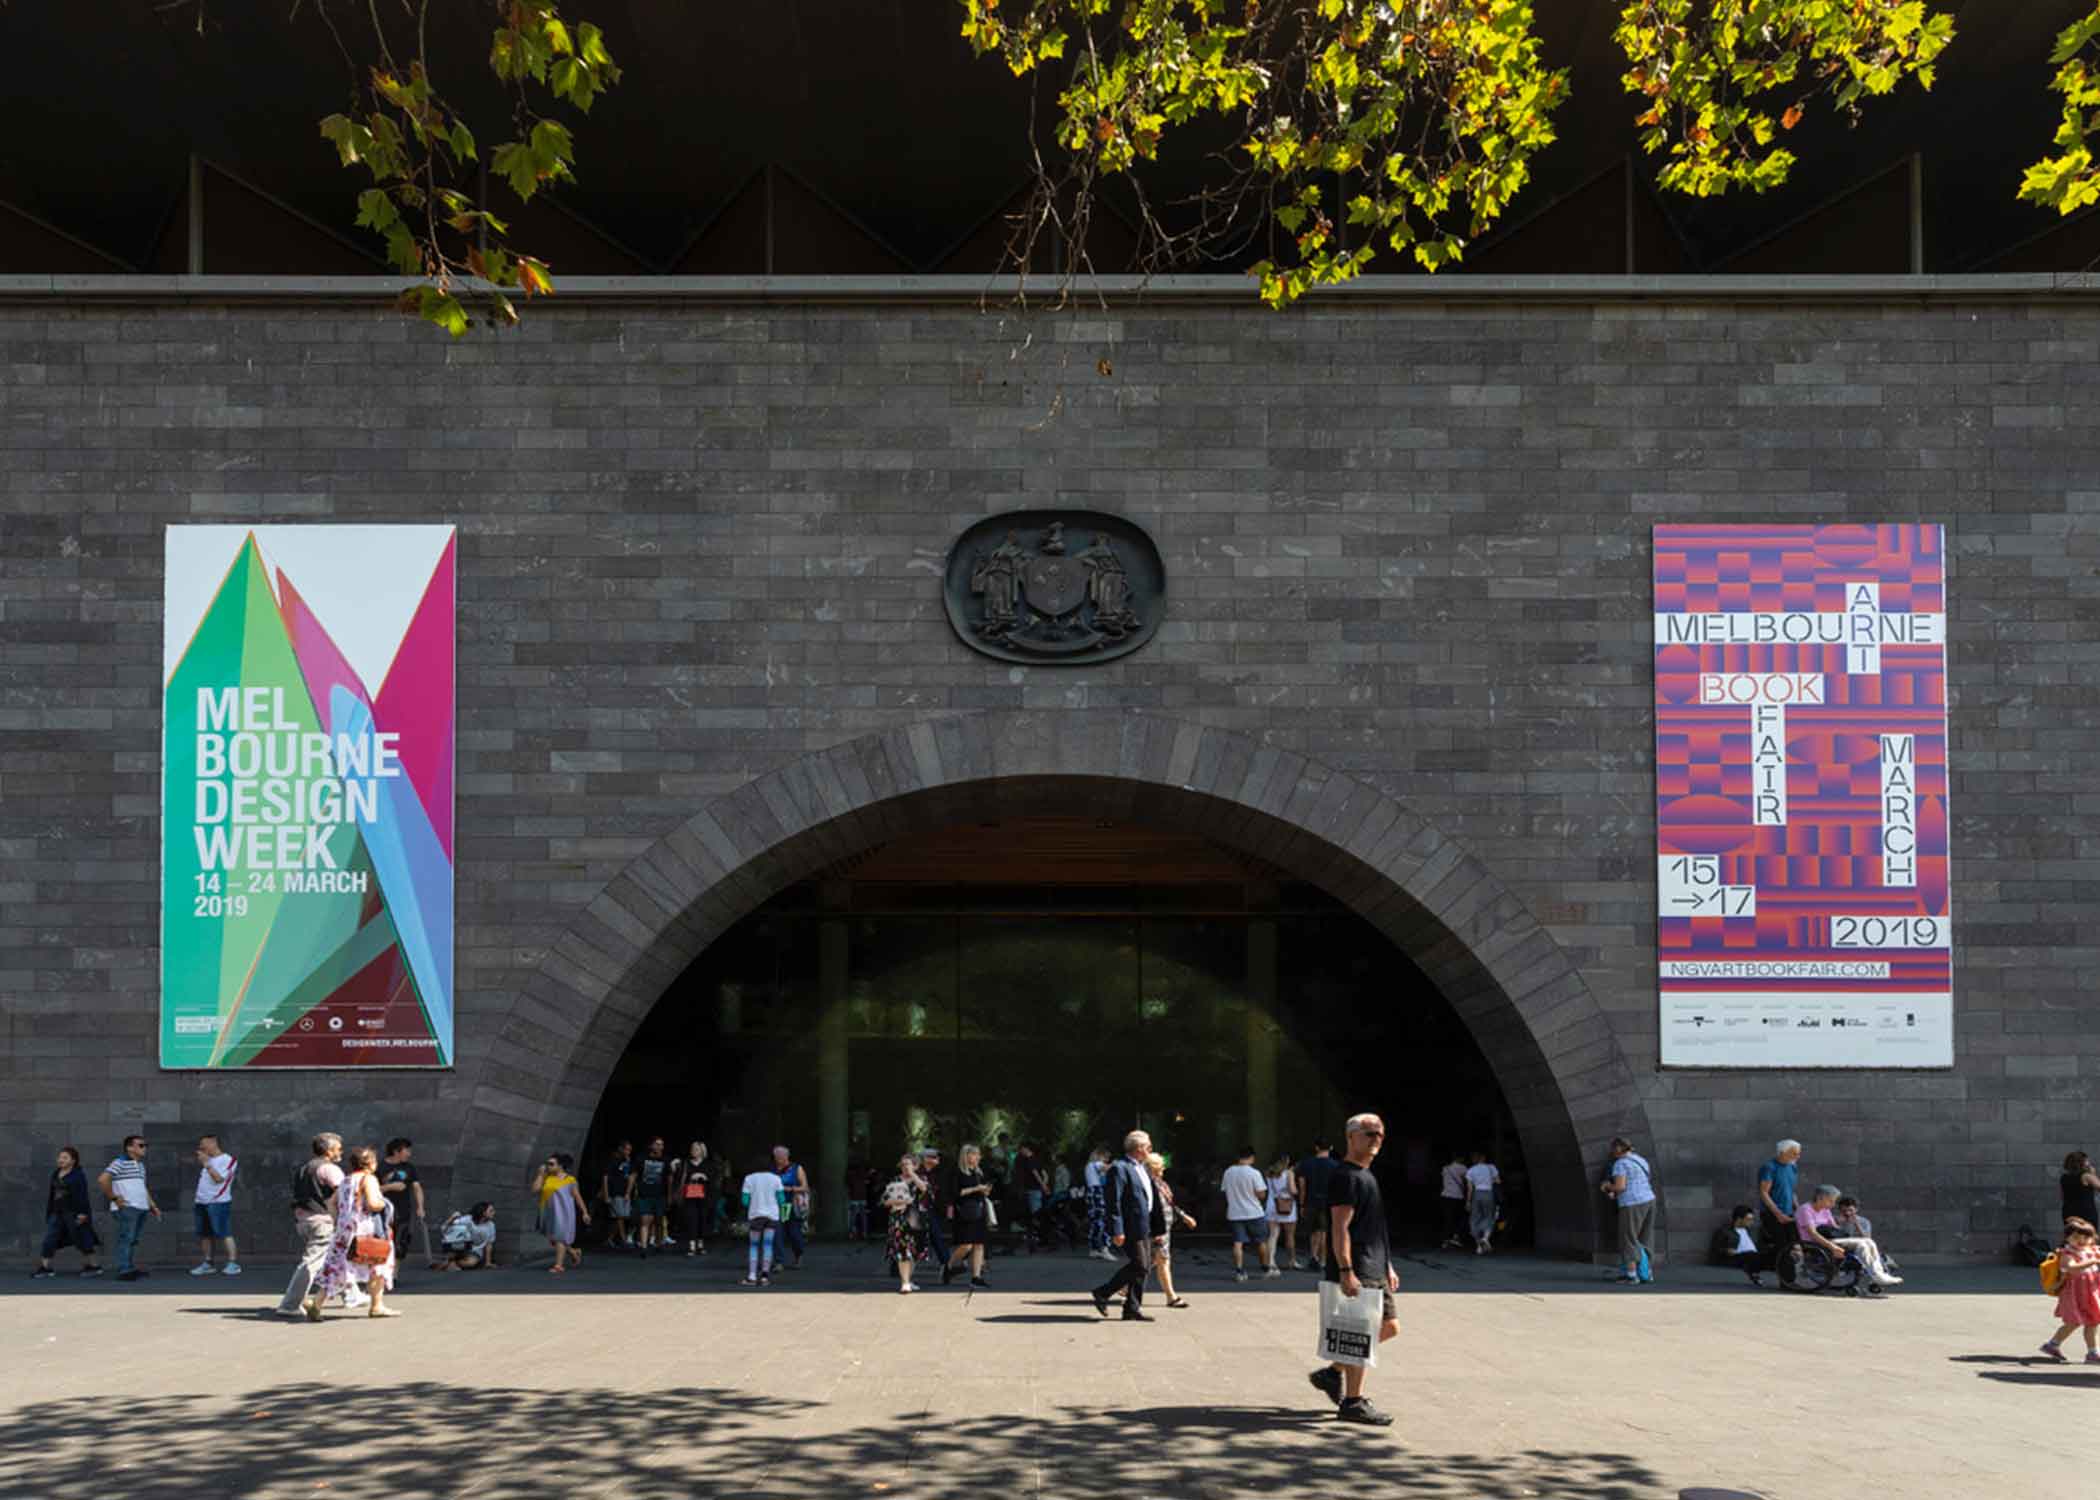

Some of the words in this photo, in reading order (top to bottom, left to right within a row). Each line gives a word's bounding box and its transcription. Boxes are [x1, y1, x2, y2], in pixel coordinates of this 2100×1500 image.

[1666, 614, 1932, 643] MELBOURNE
[1849, 584, 1876, 672] ART
[1701, 674, 1821, 703] BOOK
[196, 687, 300, 731] MEL
[196, 732, 400, 777] BOURNE
[1755, 704, 1782, 823] FAIR
[194, 778, 378, 823] DESIGN
[1881, 735, 1913, 884] MARCH
[193, 825, 337, 870] WEEK
[194, 872, 221, 893] 14
[247, 872, 276, 892] 24
[284, 872, 367, 892] MARCH
[1671, 856, 1716, 885] 15
[194, 896, 248, 917] 2019
[1835, 917, 1938, 946] 2019
[1670, 962, 1886, 977] NGVARTBOOKFAIR.COM
